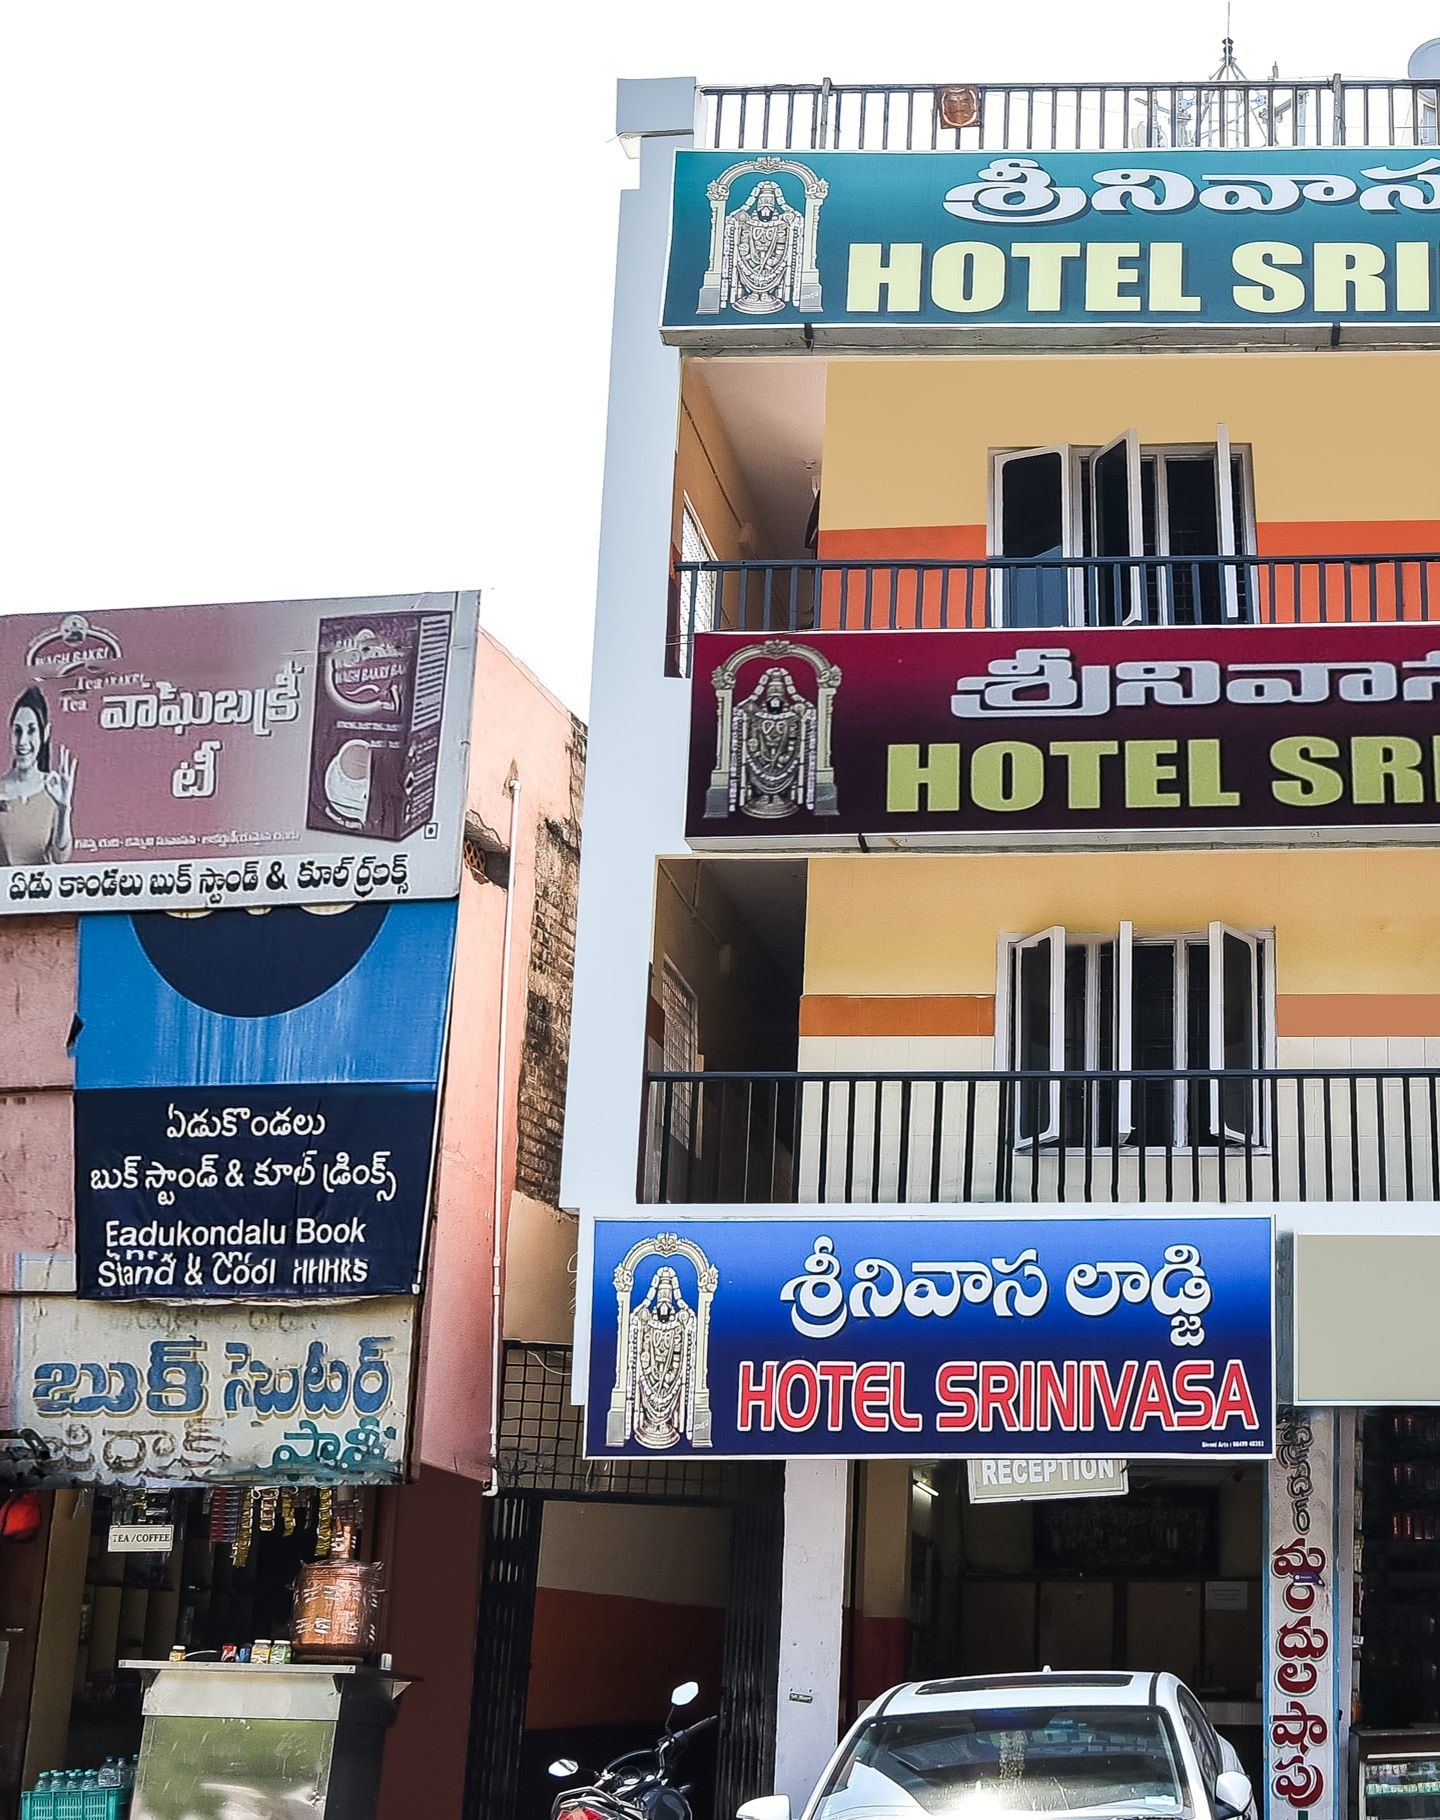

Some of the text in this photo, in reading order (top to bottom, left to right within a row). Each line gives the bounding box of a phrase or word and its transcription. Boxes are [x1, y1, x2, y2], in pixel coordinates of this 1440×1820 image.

[846, 240, 1202, 314] HOTEL
[886, 738, 1240, 813] HOTEL
[9, 870, 52, 900] ఏడు
[149, 863, 192, 895] బుక్
[266, 864, 287, 892] &
[165, 1103, 326, 1139] ఏడుకొండలు
[90, 1150, 397, 1206] బుక్ స్టాండ్ & కూల్ డ్రింక్స్
[105, 1216, 366, 1248] Eadukondalu Book
[98, 1255, 175, 1288] Stand
[184, 1256, 203, 1286] &
[212, 1257, 276, 1286] Cool
[779, 1235, 1213, 1347] శ్రీనివాస లాడ్జి
[737, 1359, 1260, 1433] HOTEL SRINIVASA
[981, 1459, 1114, 1486] RECEPTION
[112, 1533, 170, 1543] TEA/COFFEE
